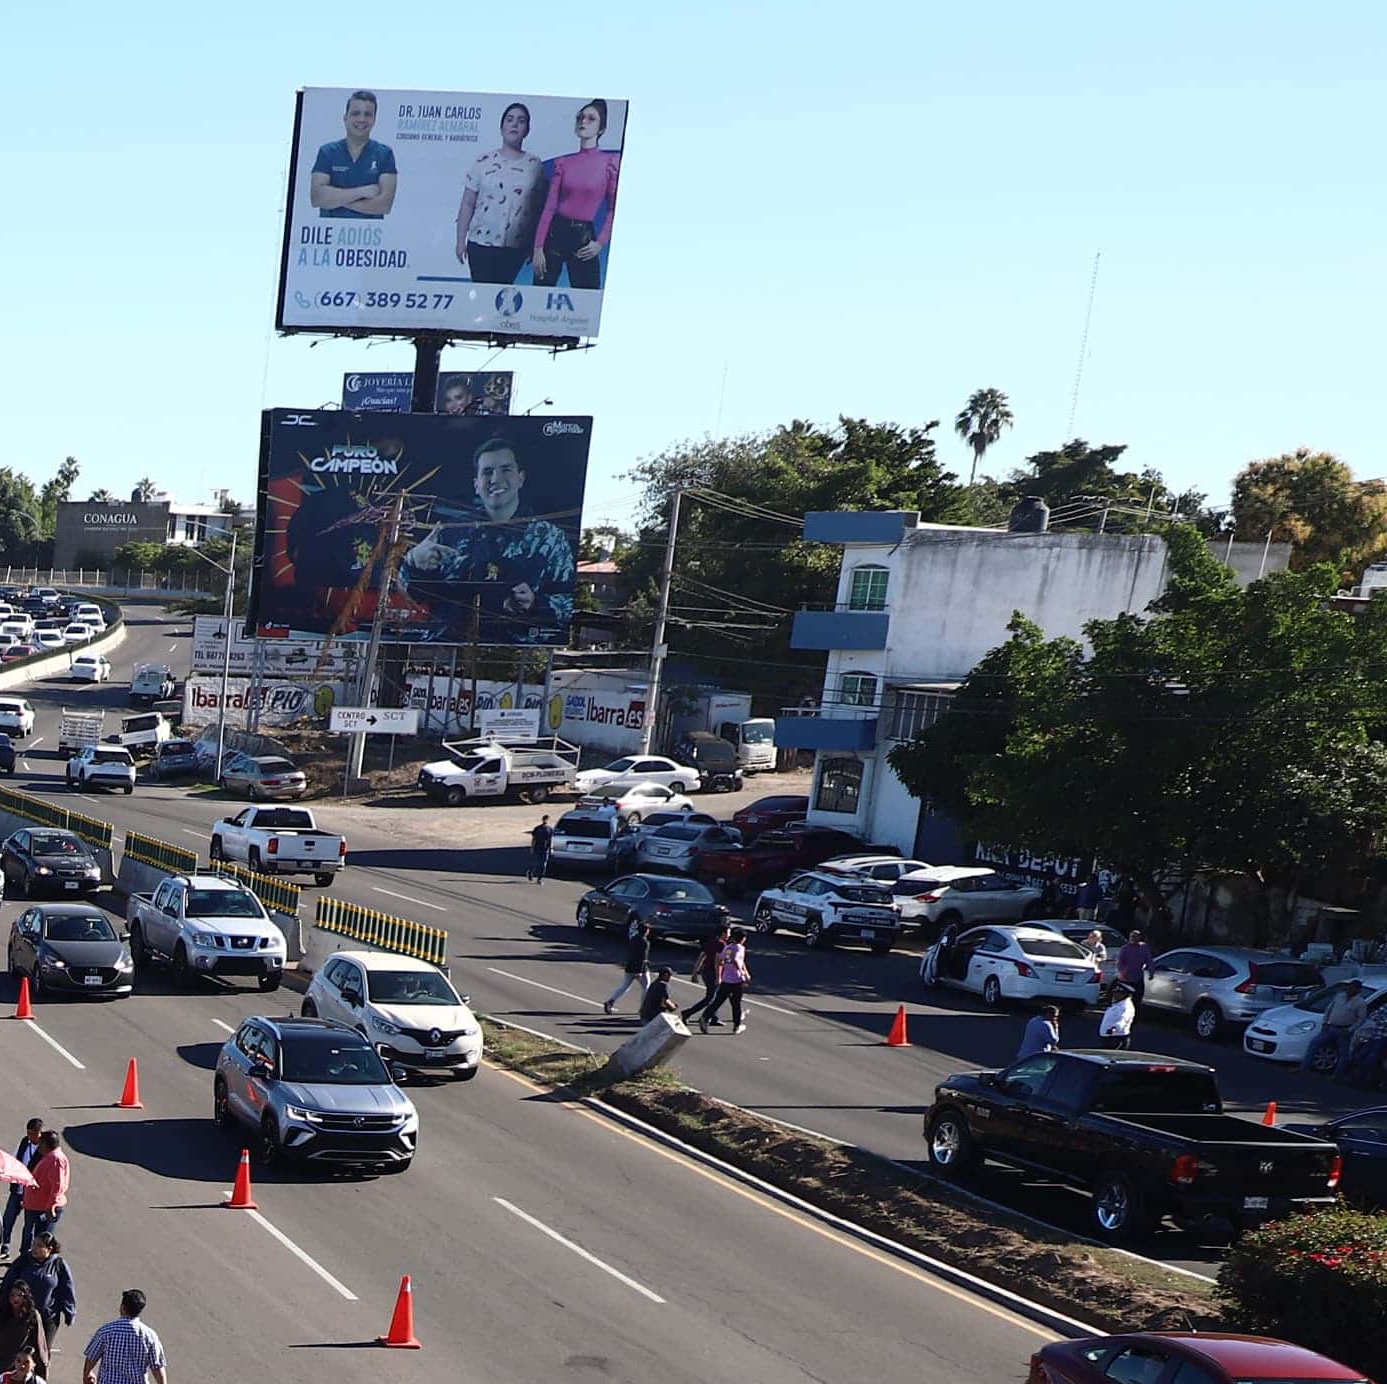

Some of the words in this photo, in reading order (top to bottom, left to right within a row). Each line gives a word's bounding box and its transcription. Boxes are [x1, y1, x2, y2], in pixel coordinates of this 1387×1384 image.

[398, 104, 415, 118] DR.
[417, 104, 442, 119] JUAN
[444, 106, 481, 120] CARLOS
[301, 226, 333, 245] DILE
[336, 225, 382, 246] ADIÓS
[298, 249, 307, 266] A
[313, 249, 331, 267] LA
[365, 292, 401, 309] 389
[405, 293, 428, 310] 52
[431, 294, 455, 311] 77
[310, 456, 399, 475] CAMPEÓN
[84, 513, 137, 524] CONAGUA
[337, 711, 365, 720] CENTRO
[382, 711, 407, 721] SCT
[344, 720, 358, 729] SCT
[1019, 848, 1082, 878] DEPOT
